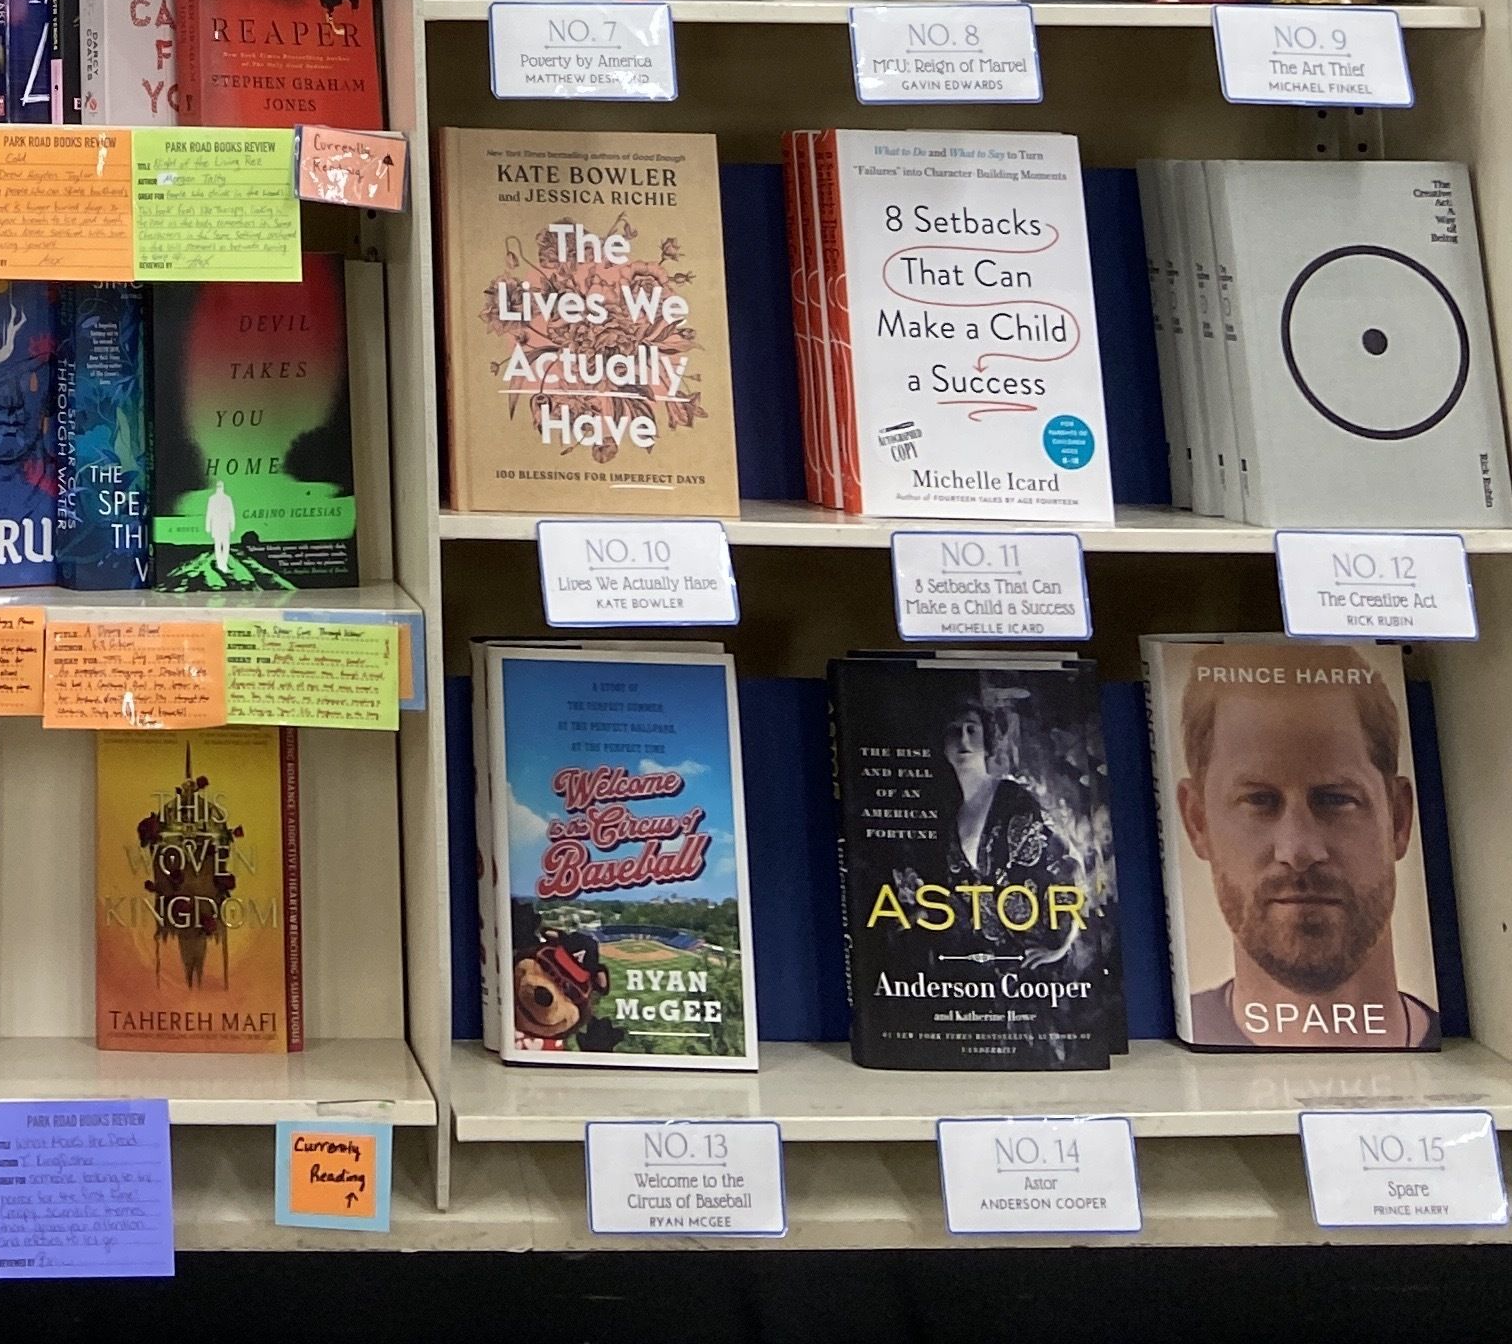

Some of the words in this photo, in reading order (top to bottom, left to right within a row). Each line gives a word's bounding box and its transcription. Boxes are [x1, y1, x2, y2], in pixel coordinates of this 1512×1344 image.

[549, 224, 631, 265] The
[497, 282, 607, 323] Lives
[622, 285, 689, 325] We
[503, 344, 687, 397] Actually
[541, 404, 657, 447] Have
[1198, 666, 1285, 683] PRINCE
[1296, 667, 1375, 685] HARRY
[867, 884, 1087, 931] ASTOR
[1245, 1002, 1386, 1034] SPARE
